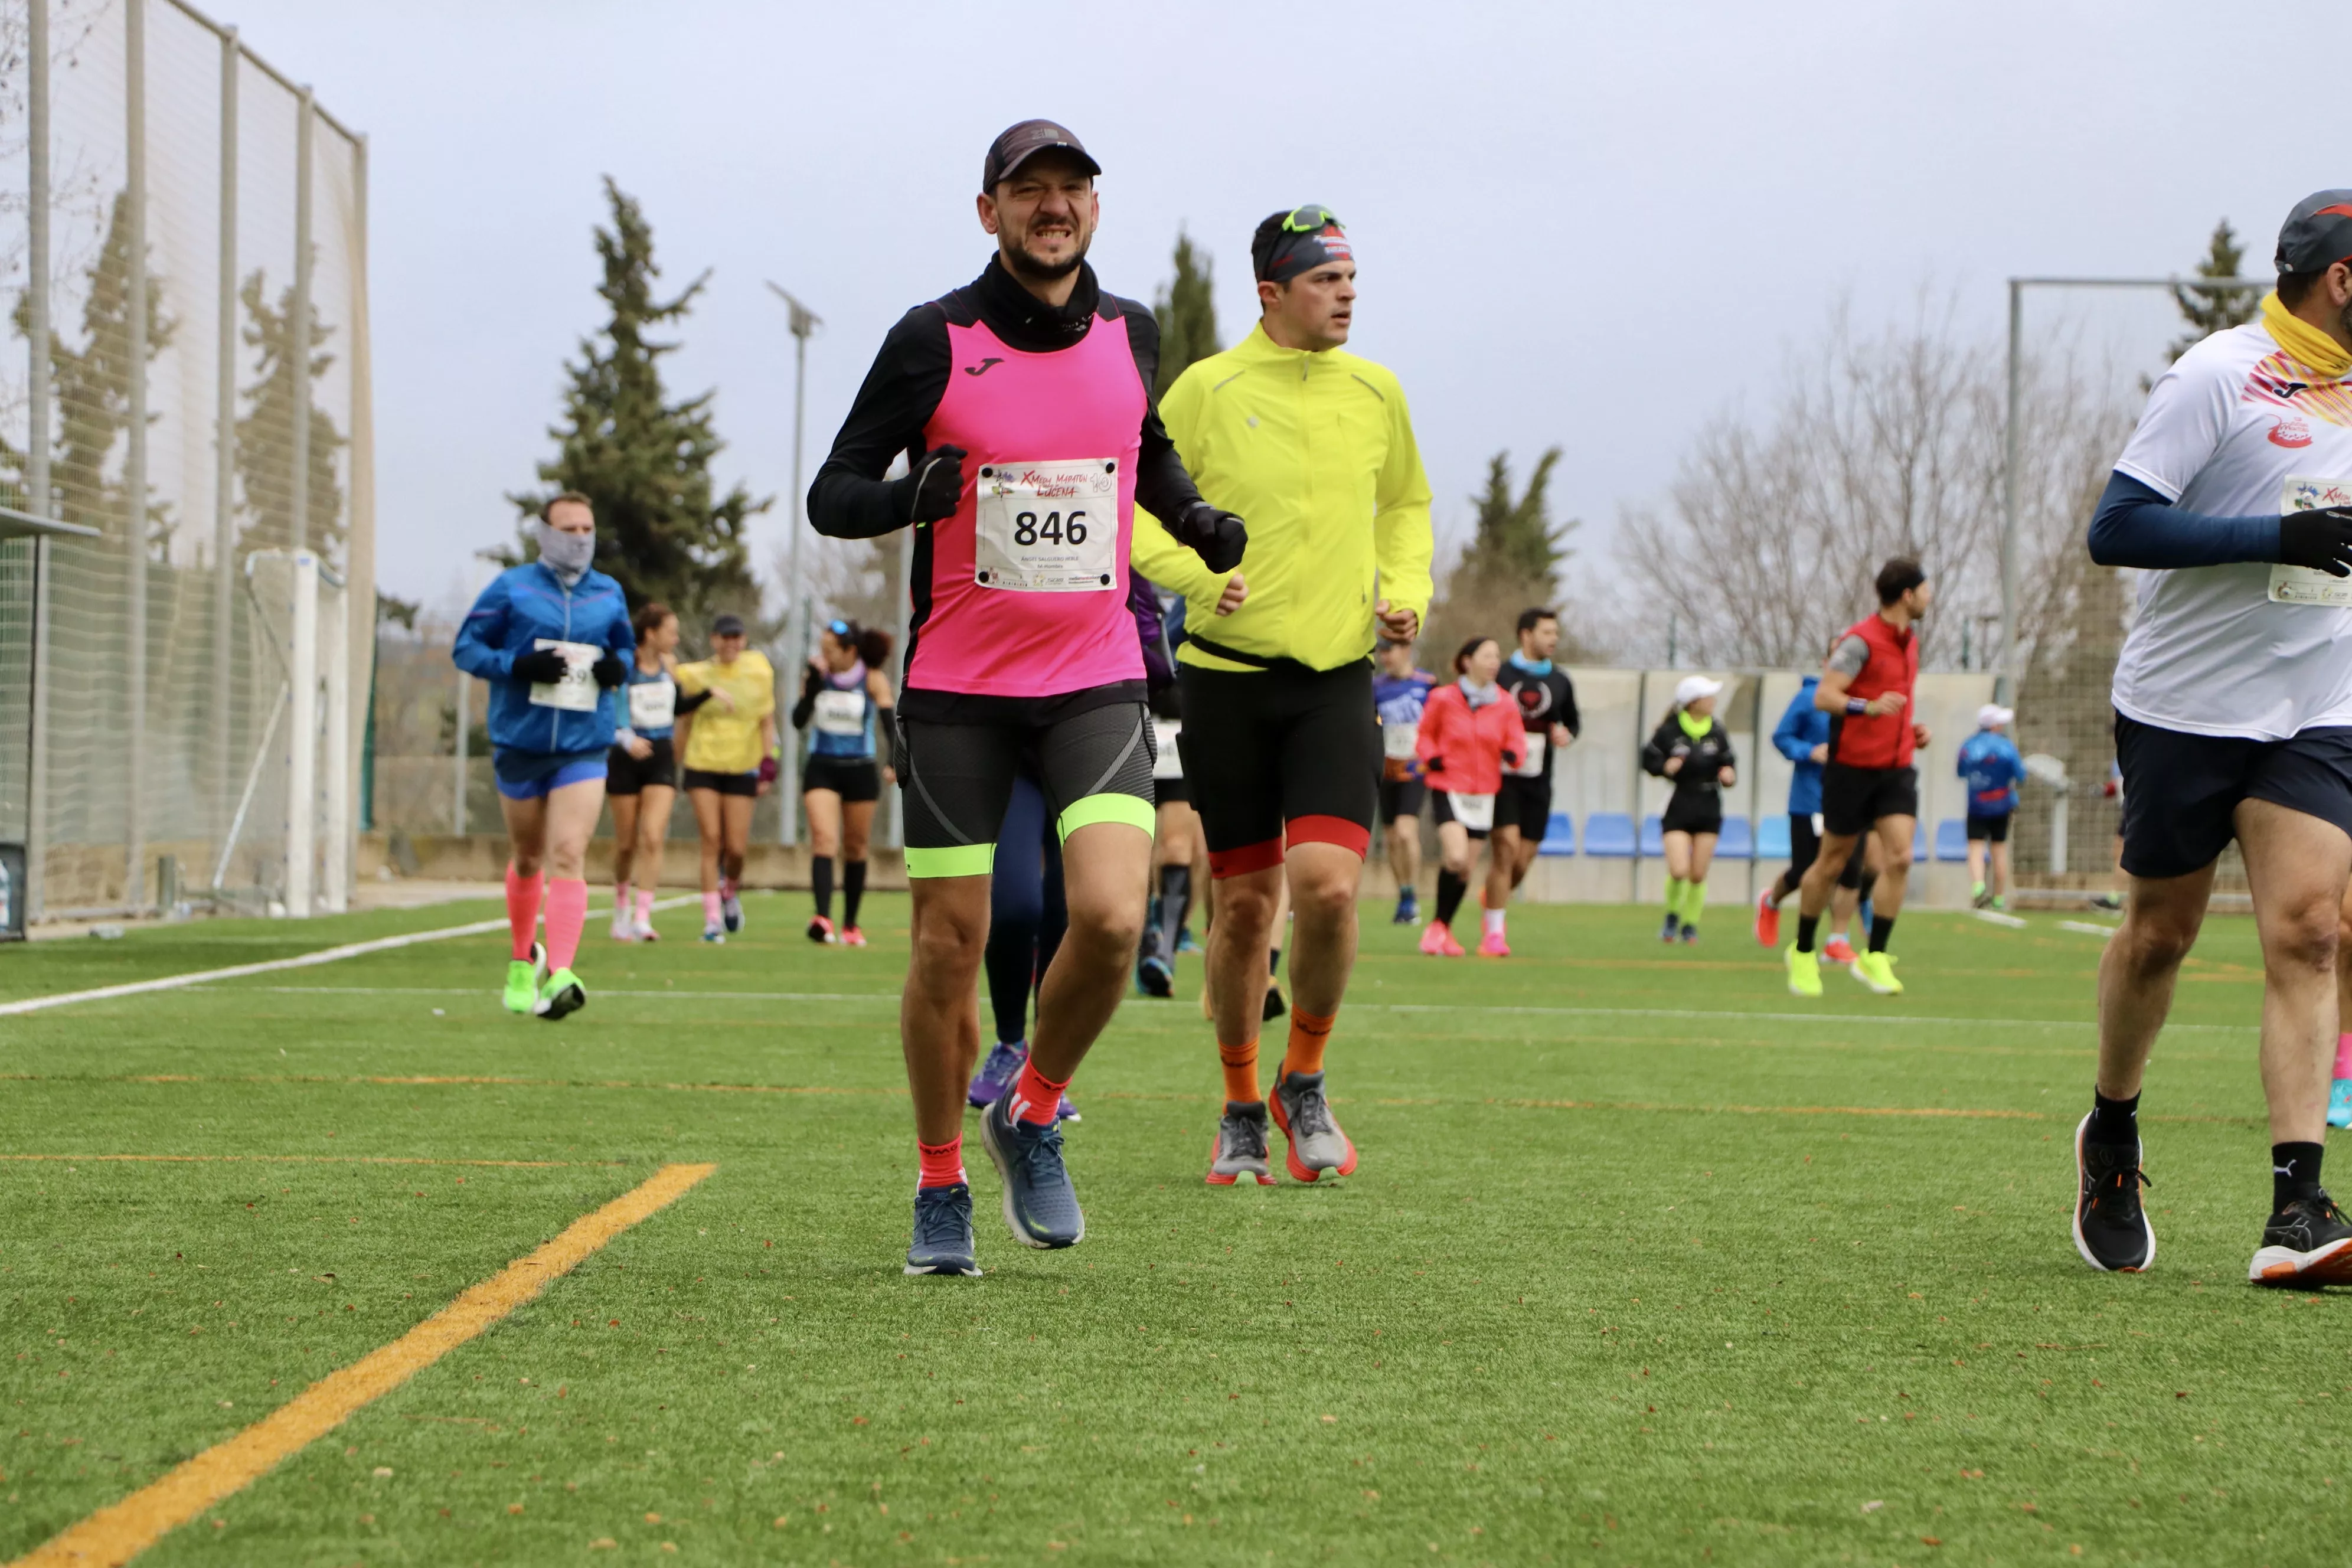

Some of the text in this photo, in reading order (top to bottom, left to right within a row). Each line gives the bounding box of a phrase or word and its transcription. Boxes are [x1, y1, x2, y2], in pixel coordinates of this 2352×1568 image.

[1020, 470, 1035, 488] X
[1036, 485, 1079, 498] LUCENA
[1014, 511, 1087, 545] 846
